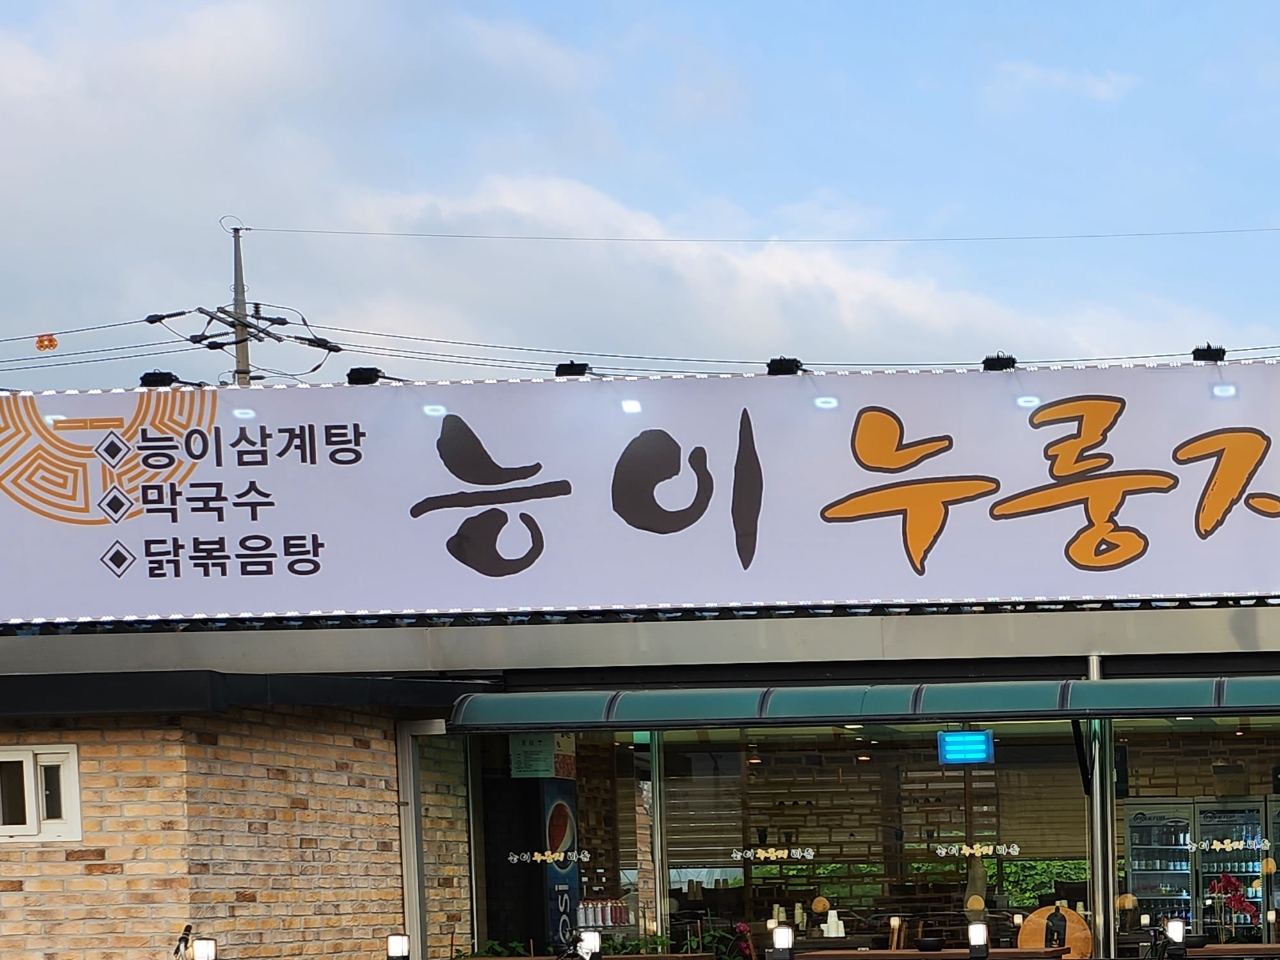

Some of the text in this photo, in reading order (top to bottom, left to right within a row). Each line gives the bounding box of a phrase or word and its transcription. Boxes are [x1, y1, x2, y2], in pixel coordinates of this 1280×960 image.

[135, 422, 366, 469] 능이삼계탕
[139, 480, 276, 524] 막국수
[408, 407, 764, 578] 능이
[143, 534, 326, 578] 닭볶음탕
